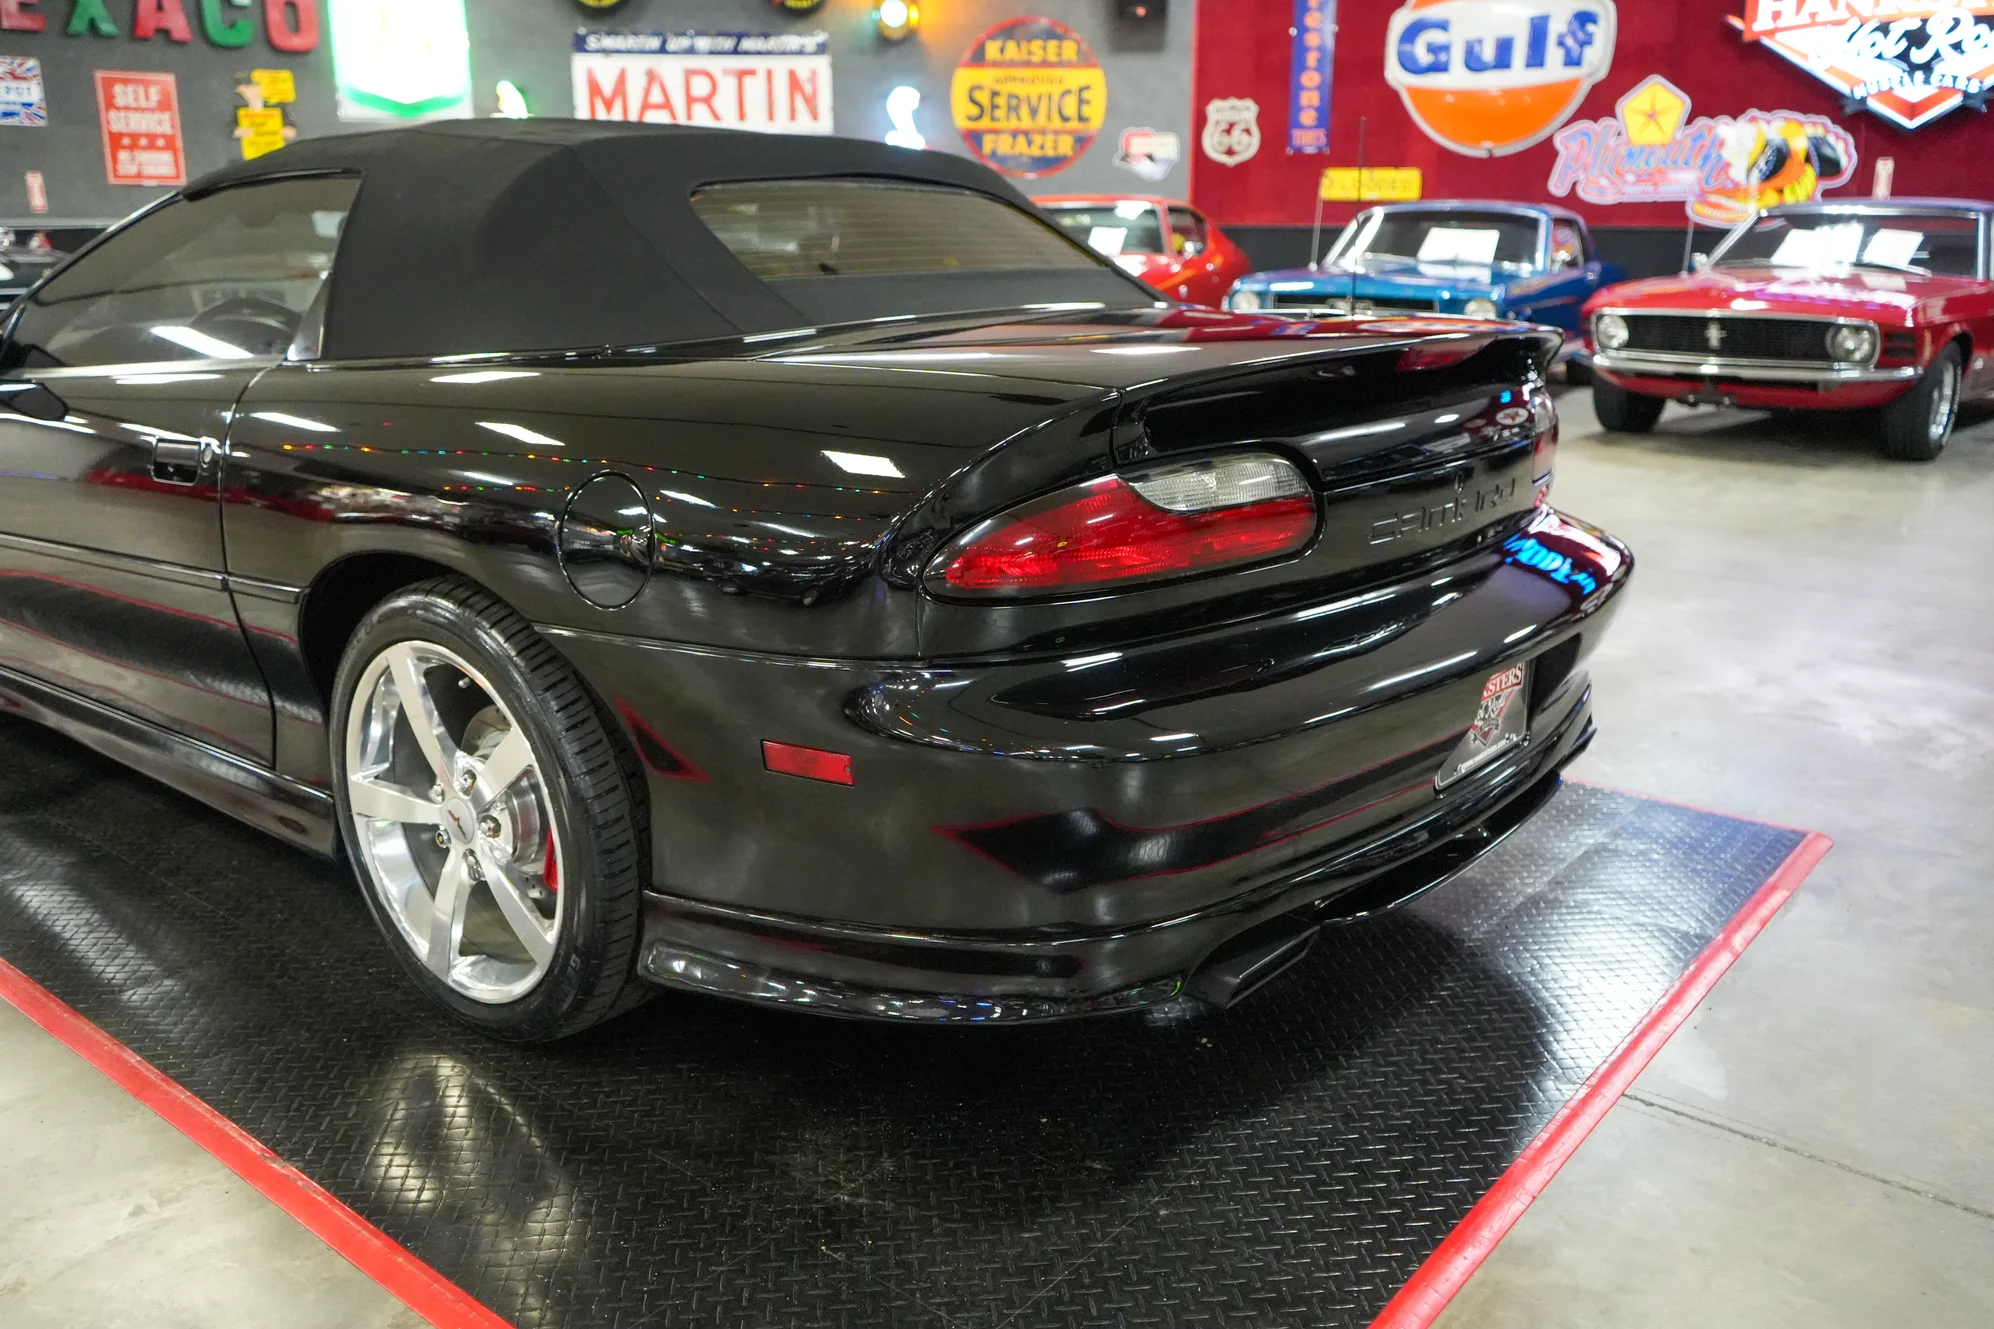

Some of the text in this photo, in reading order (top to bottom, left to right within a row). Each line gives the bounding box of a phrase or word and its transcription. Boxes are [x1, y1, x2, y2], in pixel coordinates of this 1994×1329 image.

[984, 39, 1080, 63] KAISER
[1397, 9, 1599, 75] Gulf
[111, 83, 162, 108] SELF
[586, 67, 819, 123] MARTIN
[1929, 73, 1982, 94] CARS
[966, 84, 1092, 123] SERVICE
[107, 108, 174, 135] SERVICE
[1213, 119, 1253, 156] 66
[981, 132, 1076, 158] FRAZER
[1550, 121, 1730, 188] Plymouth
